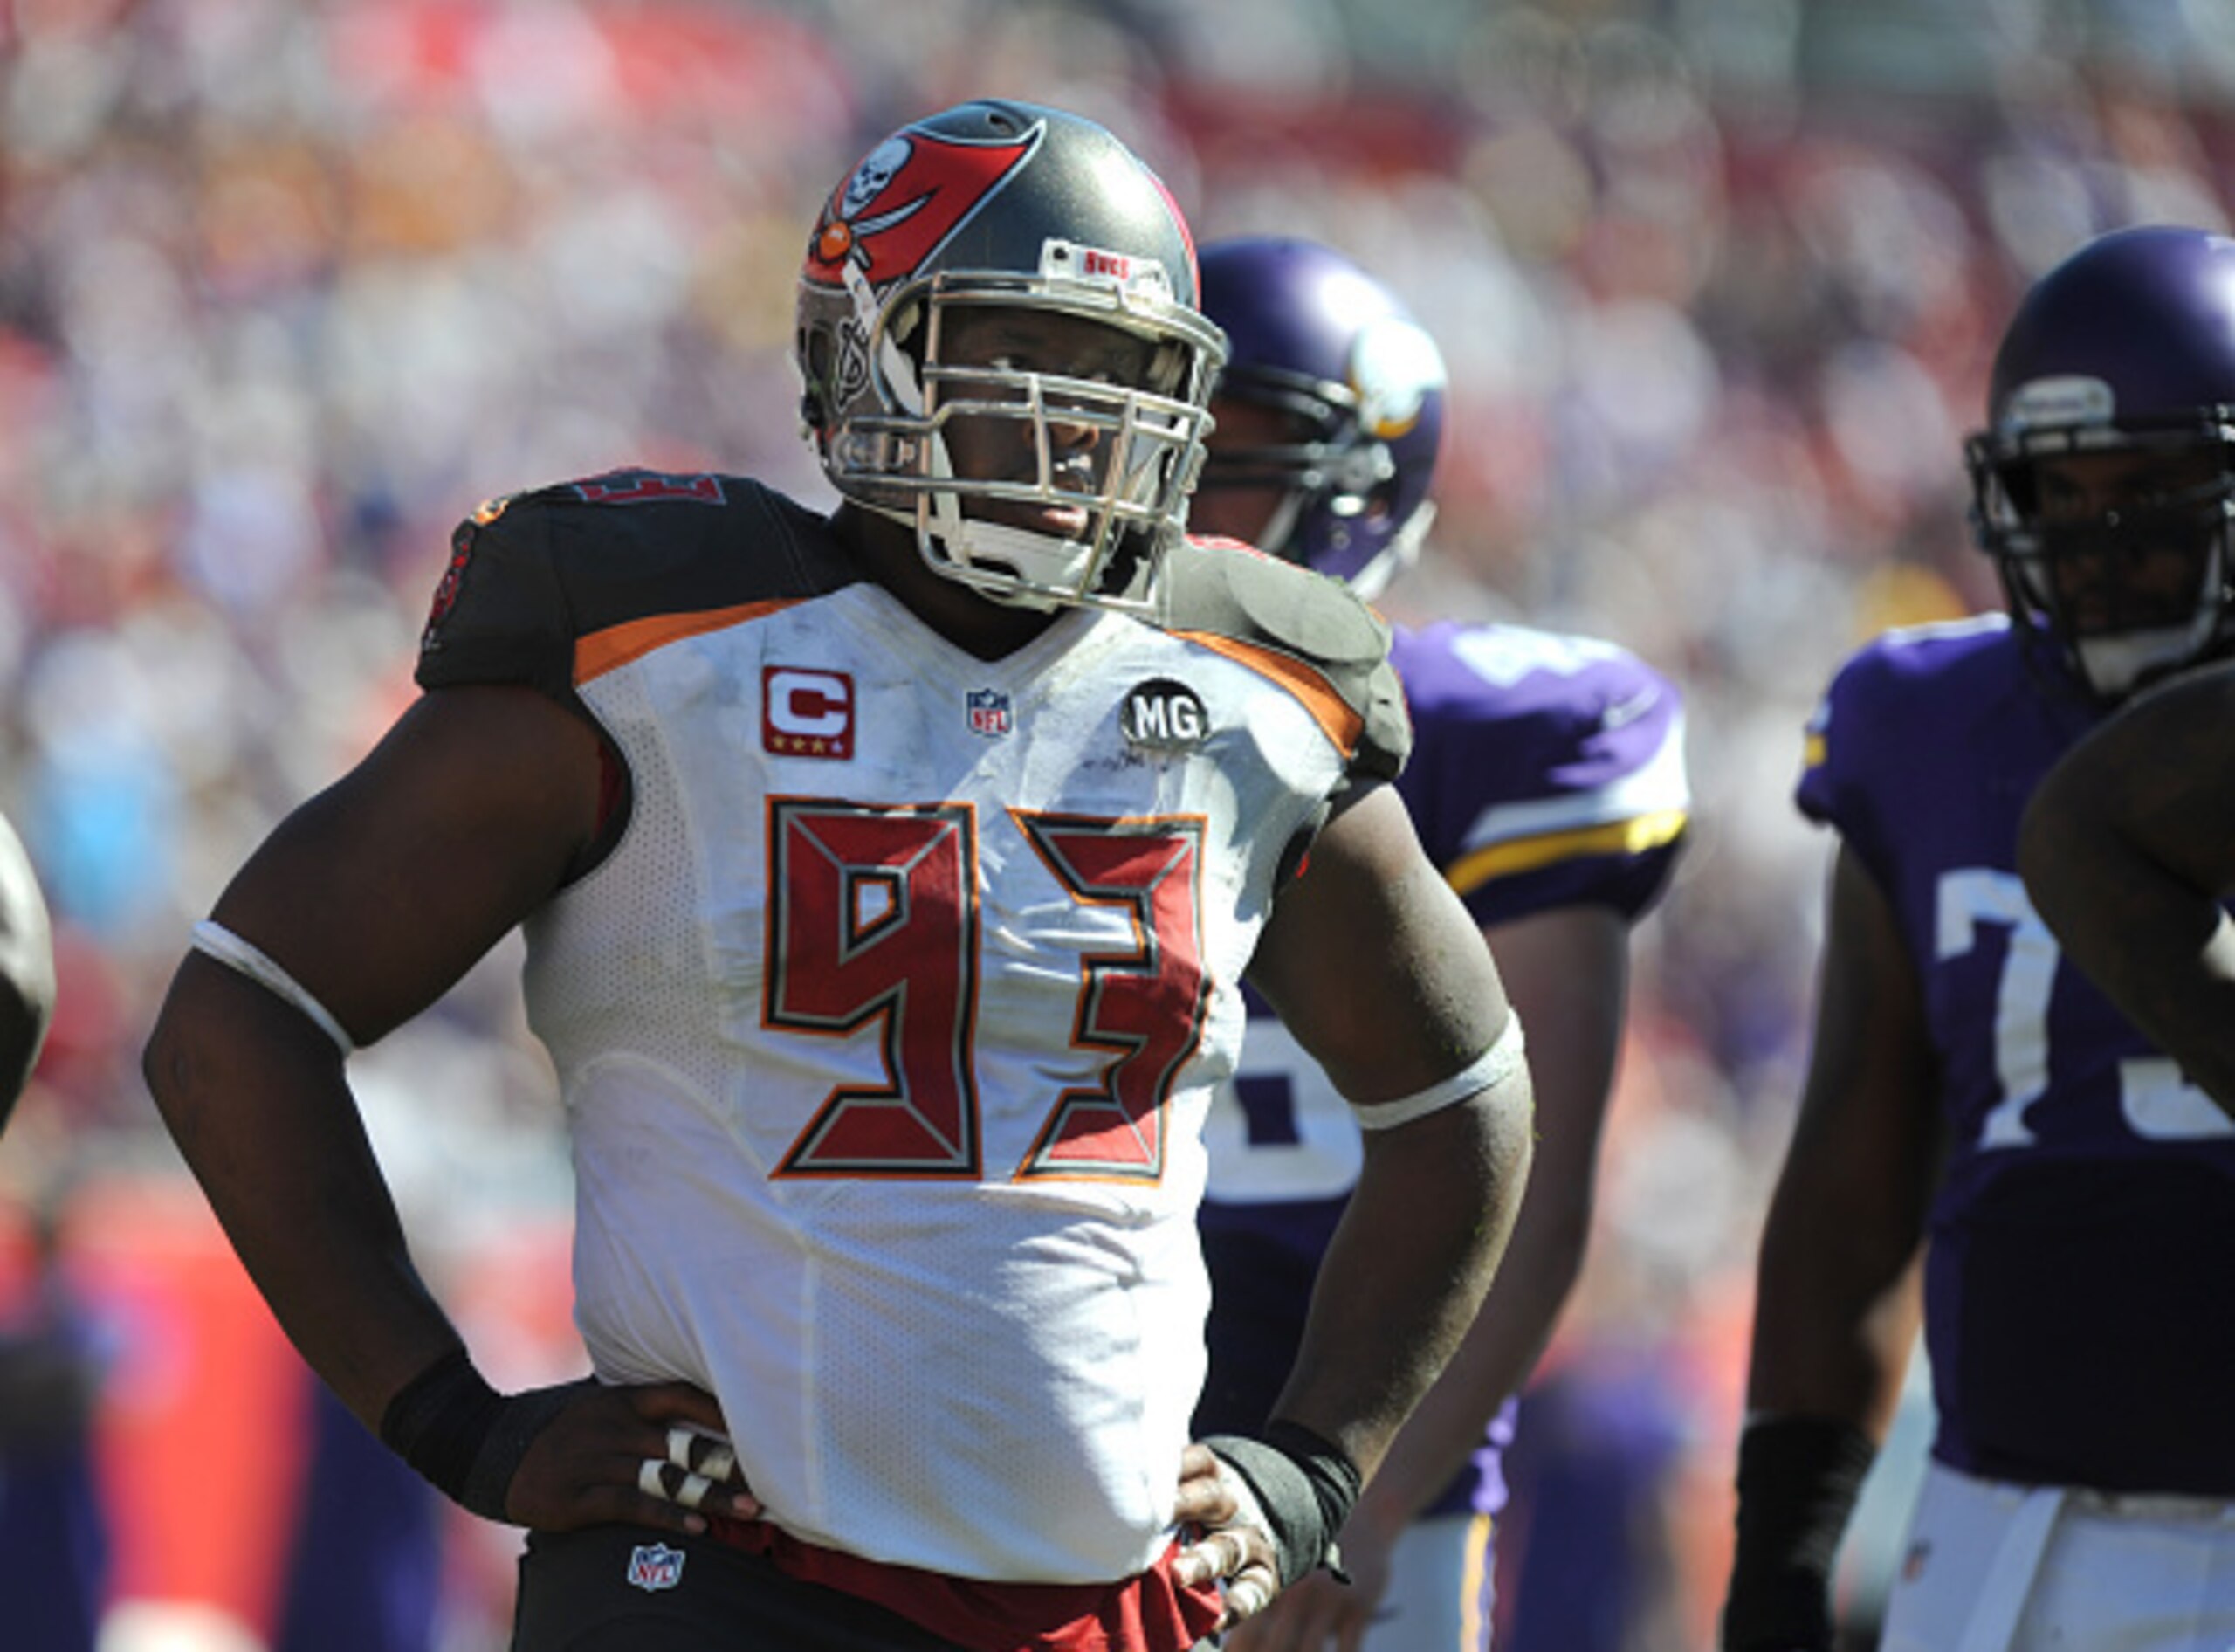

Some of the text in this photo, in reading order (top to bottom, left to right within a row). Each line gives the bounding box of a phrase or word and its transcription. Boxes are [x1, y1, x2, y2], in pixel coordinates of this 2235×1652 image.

[768, 671, 848, 738] C
[971, 709, 1010, 733] NFL
[1132, 695, 1201, 740] MG
[760, 794, 1214, 1188] 93
[637, 1563, 674, 1583] NFL
